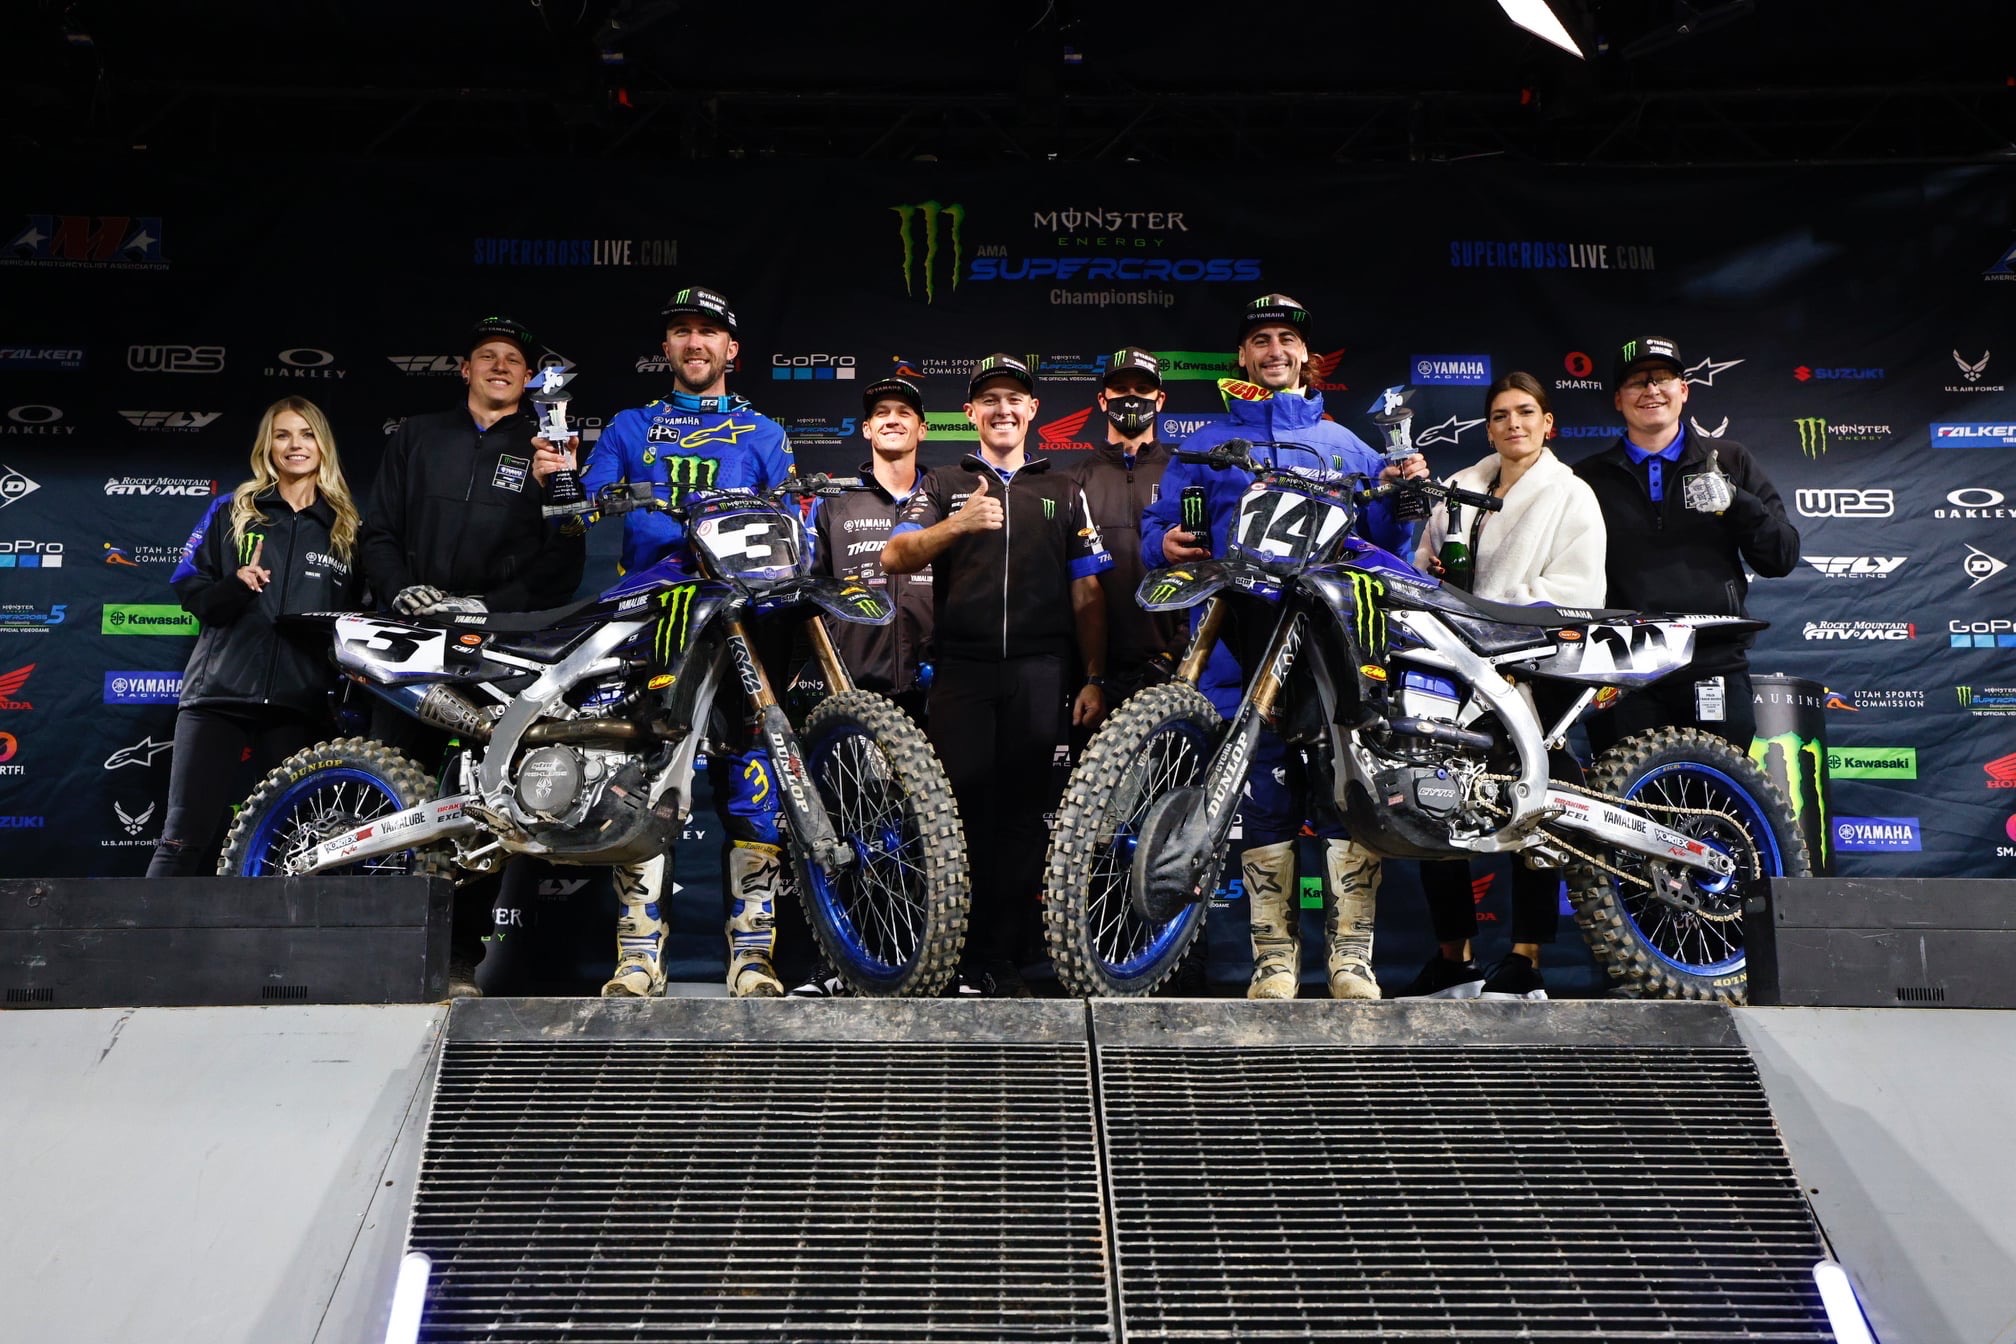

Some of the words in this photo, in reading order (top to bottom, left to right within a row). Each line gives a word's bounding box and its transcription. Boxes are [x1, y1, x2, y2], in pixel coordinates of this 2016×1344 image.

[1033, 207, 1189, 232] MONSTER
[0, 213, 164, 260] AMA
[1057, 236, 1165, 248] ENERGY
[473, 238, 678, 267] SUPERCROSSLIVE.COM
[976, 245, 1008, 257] AMA
[1449, 240, 1656, 271] SUPERCROSSLIVE.COM
[39, 260, 109, 270] MOTORCYCLIST
[110, 262, 170, 272] ASSOCIATION
[967, 257, 1263, 282] SUPERCROSS
[1050, 288, 1175, 308] Championship
[1257, 312, 1286, 320] YAMAHA
[127, 345, 226, 374] WPS
[772, 353, 857, 368] GoPro
[922, 358, 947, 367] UTAH
[950, 359, 982, 368] SPORT
[264, 367, 347, 380] OAKLEY
[922, 367, 971, 376] COMMISSI
[1432, 361, 1484, 375] YAMAHA
[1815, 367, 1885, 380] SUZUKI
[1219, 380, 1276, 402] 100%
[1556, 380, 1603, 391] SMARTFI
[700, 399, 719, 407] ET3
[117, 409, 224, 428] FLY
[567, 415, 603, 428] Pro
[664, 416, 700, 427] YAMAHA
[0, 425, 77, 436] AKLEY
[649, 425, 678, 441] PPG
[837, 417, 858, 438] 5
[1560, 426, 1626, 439] SUZUK
[1828, 423, 1892, 435] MONSTER
[1038, 442, 1095, 451] HONDA
[121, 476, 153, 487] ROCKY
[155, 477, 212, 487] MOUNTAIN
[1795, 488, 1895, 519] WPS
[1934, 509, 2016, 519] OAKLEY
[854, 518, 892, 528] YAMAHA
[1241, 490, 1350, 556] 14
[0, 540, 63, 553] oPro
[718, 513, 796, 573] 3
[847, 540, 888, 556] THOR
[135, 546, 161, 554] UTAH
[167, 546, 185, 555] SPO
[135, 555, 184, 564] COMMISS
[317, 553, 347, 574] YAMAHA
[1801, 556, 1908, 574] FLY
[45, 604, 68, 624] 5
[128, 613, 193, 626] Kawasaki
[454, 614, 488, 625] YAMAHA
[1556, 608, 1593, 620] YAMAHA
[1820, 620, 1851, 630] ROCKY
[1854, 621, 1908, 631] MOUNTAIN
[1949, 619, 2016, 633] GoPr
[344, 620, 443, 663] 3
[727, 635, 763, 695] KYB
[129, 679, 183, 693] YAMAHA
[1753, 692, 1822, 710] AURINE
[1854, 690, 1881, 698] UTAH
[1885, 690, 1925, 699] SPORTS
[0, 701, 32, 710] NDA
[1855, 700, 1925, 708] COMMISSION
[1215, 743, 1233, 773] CYCRA
[1844, 757, 1909, 769] Kawasaki
[0, 765, 24, 775] RTFI
[289, 759, 343, 783] DUNLOP
[770, 732, 810, 813] DUNLOP
[1207, 731, 1248, 819] DUNLOP
[744, 759, 769, 804] 3
[437, 802, 464, 814] BRAK
[1554, 797, 1590, 812] BRAKING
[0, 815, 45, 828] ZUKI
[380, 812, 426, 835] YAMALUBE
[437, 811, 467, 823] EXCE
[1566, 811, 1590, 822] CEL
[1603, 809, 1647, 834] YAMALUBE
[1655, 828, 1690, 849] VORTEX
[1855, 824, 1913, 839] YAMAHA
[537, 878, 592, 896] LY
[1224, 879, 1244, 900] 5
